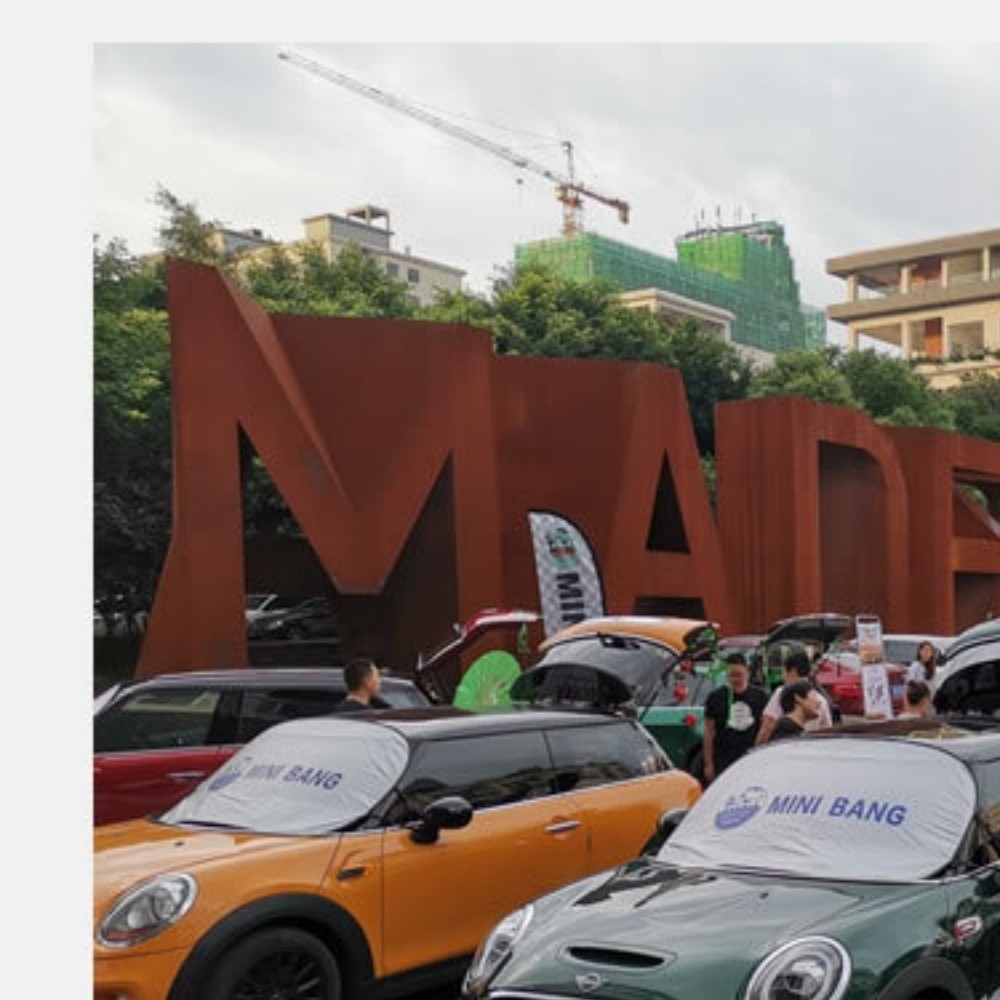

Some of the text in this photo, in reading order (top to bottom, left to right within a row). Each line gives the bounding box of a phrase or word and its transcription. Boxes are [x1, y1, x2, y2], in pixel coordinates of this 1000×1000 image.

[283, 765, 343, 790] BANG
[766, 794, 908, 827] MINI BANG
